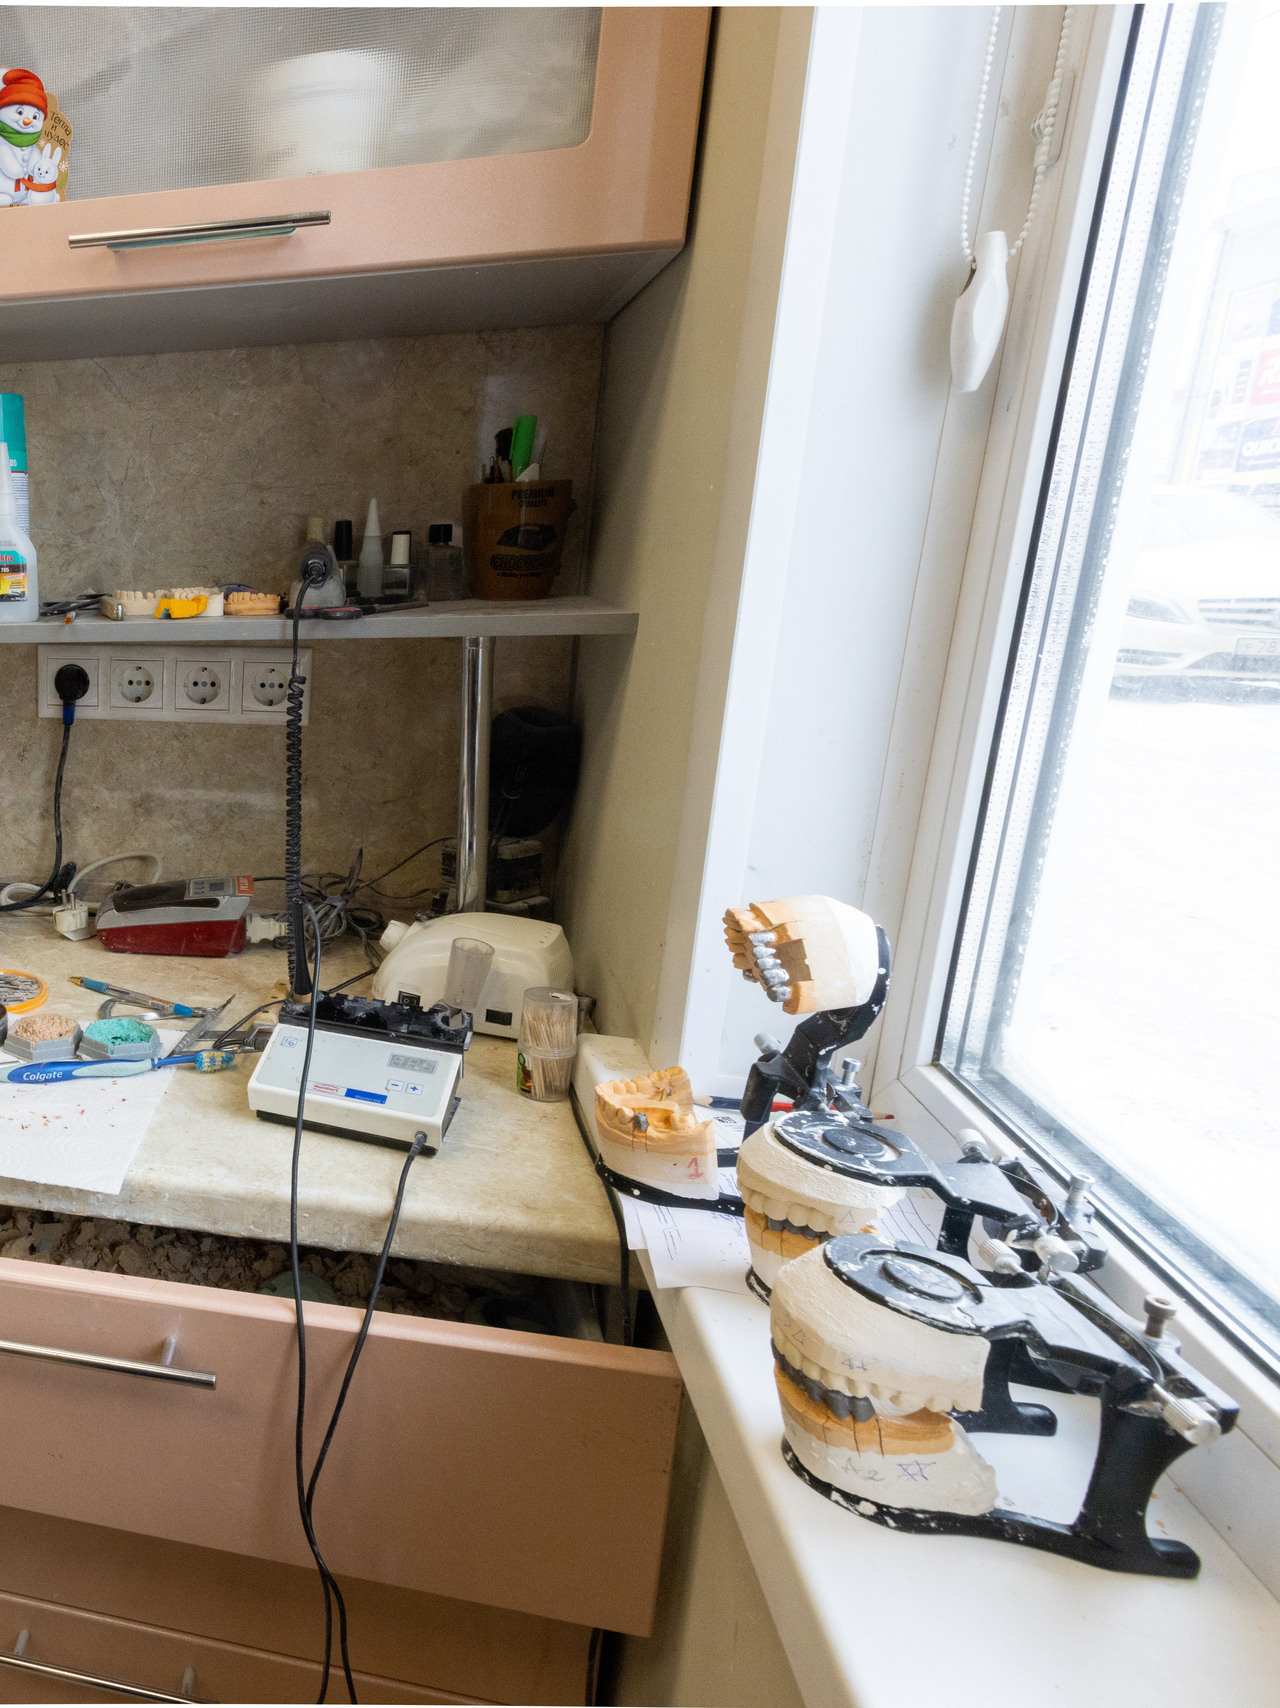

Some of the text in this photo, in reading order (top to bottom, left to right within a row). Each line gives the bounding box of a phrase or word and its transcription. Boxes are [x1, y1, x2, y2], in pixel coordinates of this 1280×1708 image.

[50, 111, 71, 136] Тепла
[44, 130, 69, 151] чудес
[512, 488, 555, 499] PREMIUM
[22, 1071, 63, 1081] Colgate
[687, 1156, 705, 1179] 1
